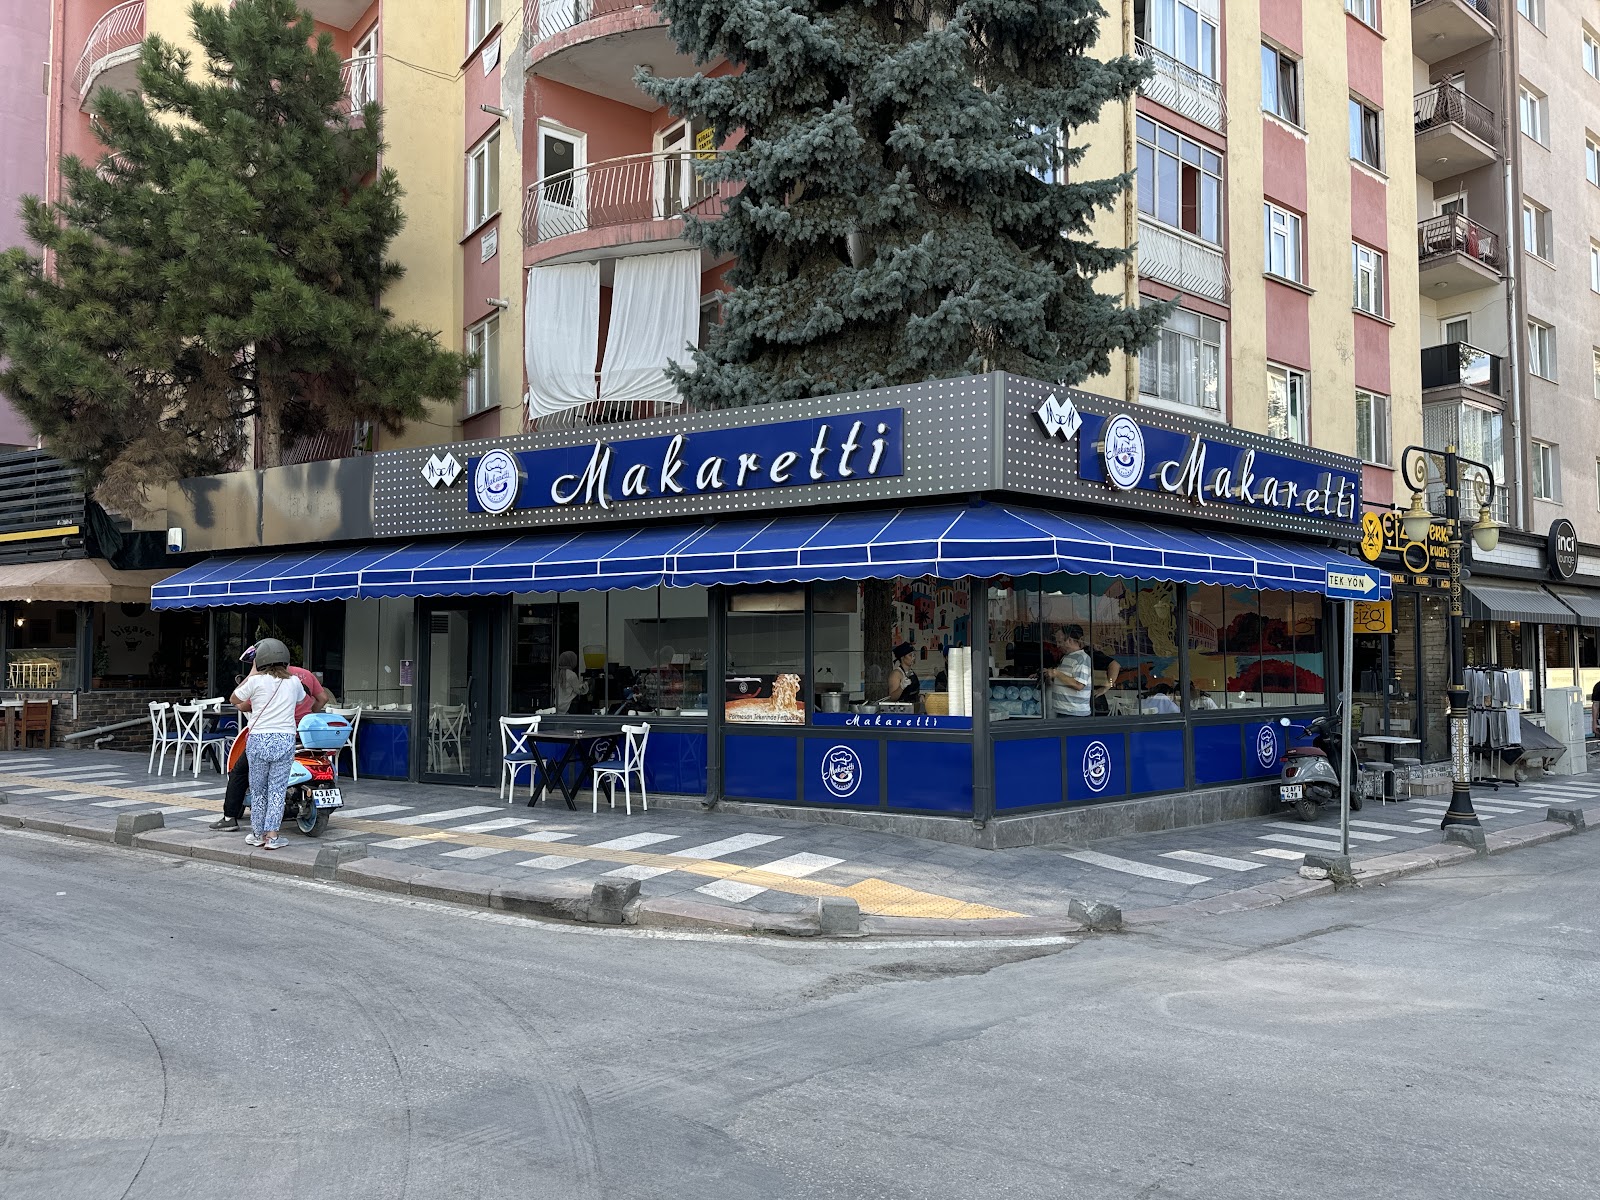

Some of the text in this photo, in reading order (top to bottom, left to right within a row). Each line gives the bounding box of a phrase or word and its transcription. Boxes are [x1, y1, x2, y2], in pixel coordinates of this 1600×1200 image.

[551, 420, 886, 509] Makaretti
[1160, 433, 1355, 519] Makaretti
[1557, 534, 1575, 552] inci
[1329, 575, 1364, 588] TEK YÖN
[111, 625, 151, 637] bigave
[845, 713, 937, 727] Makaretti
